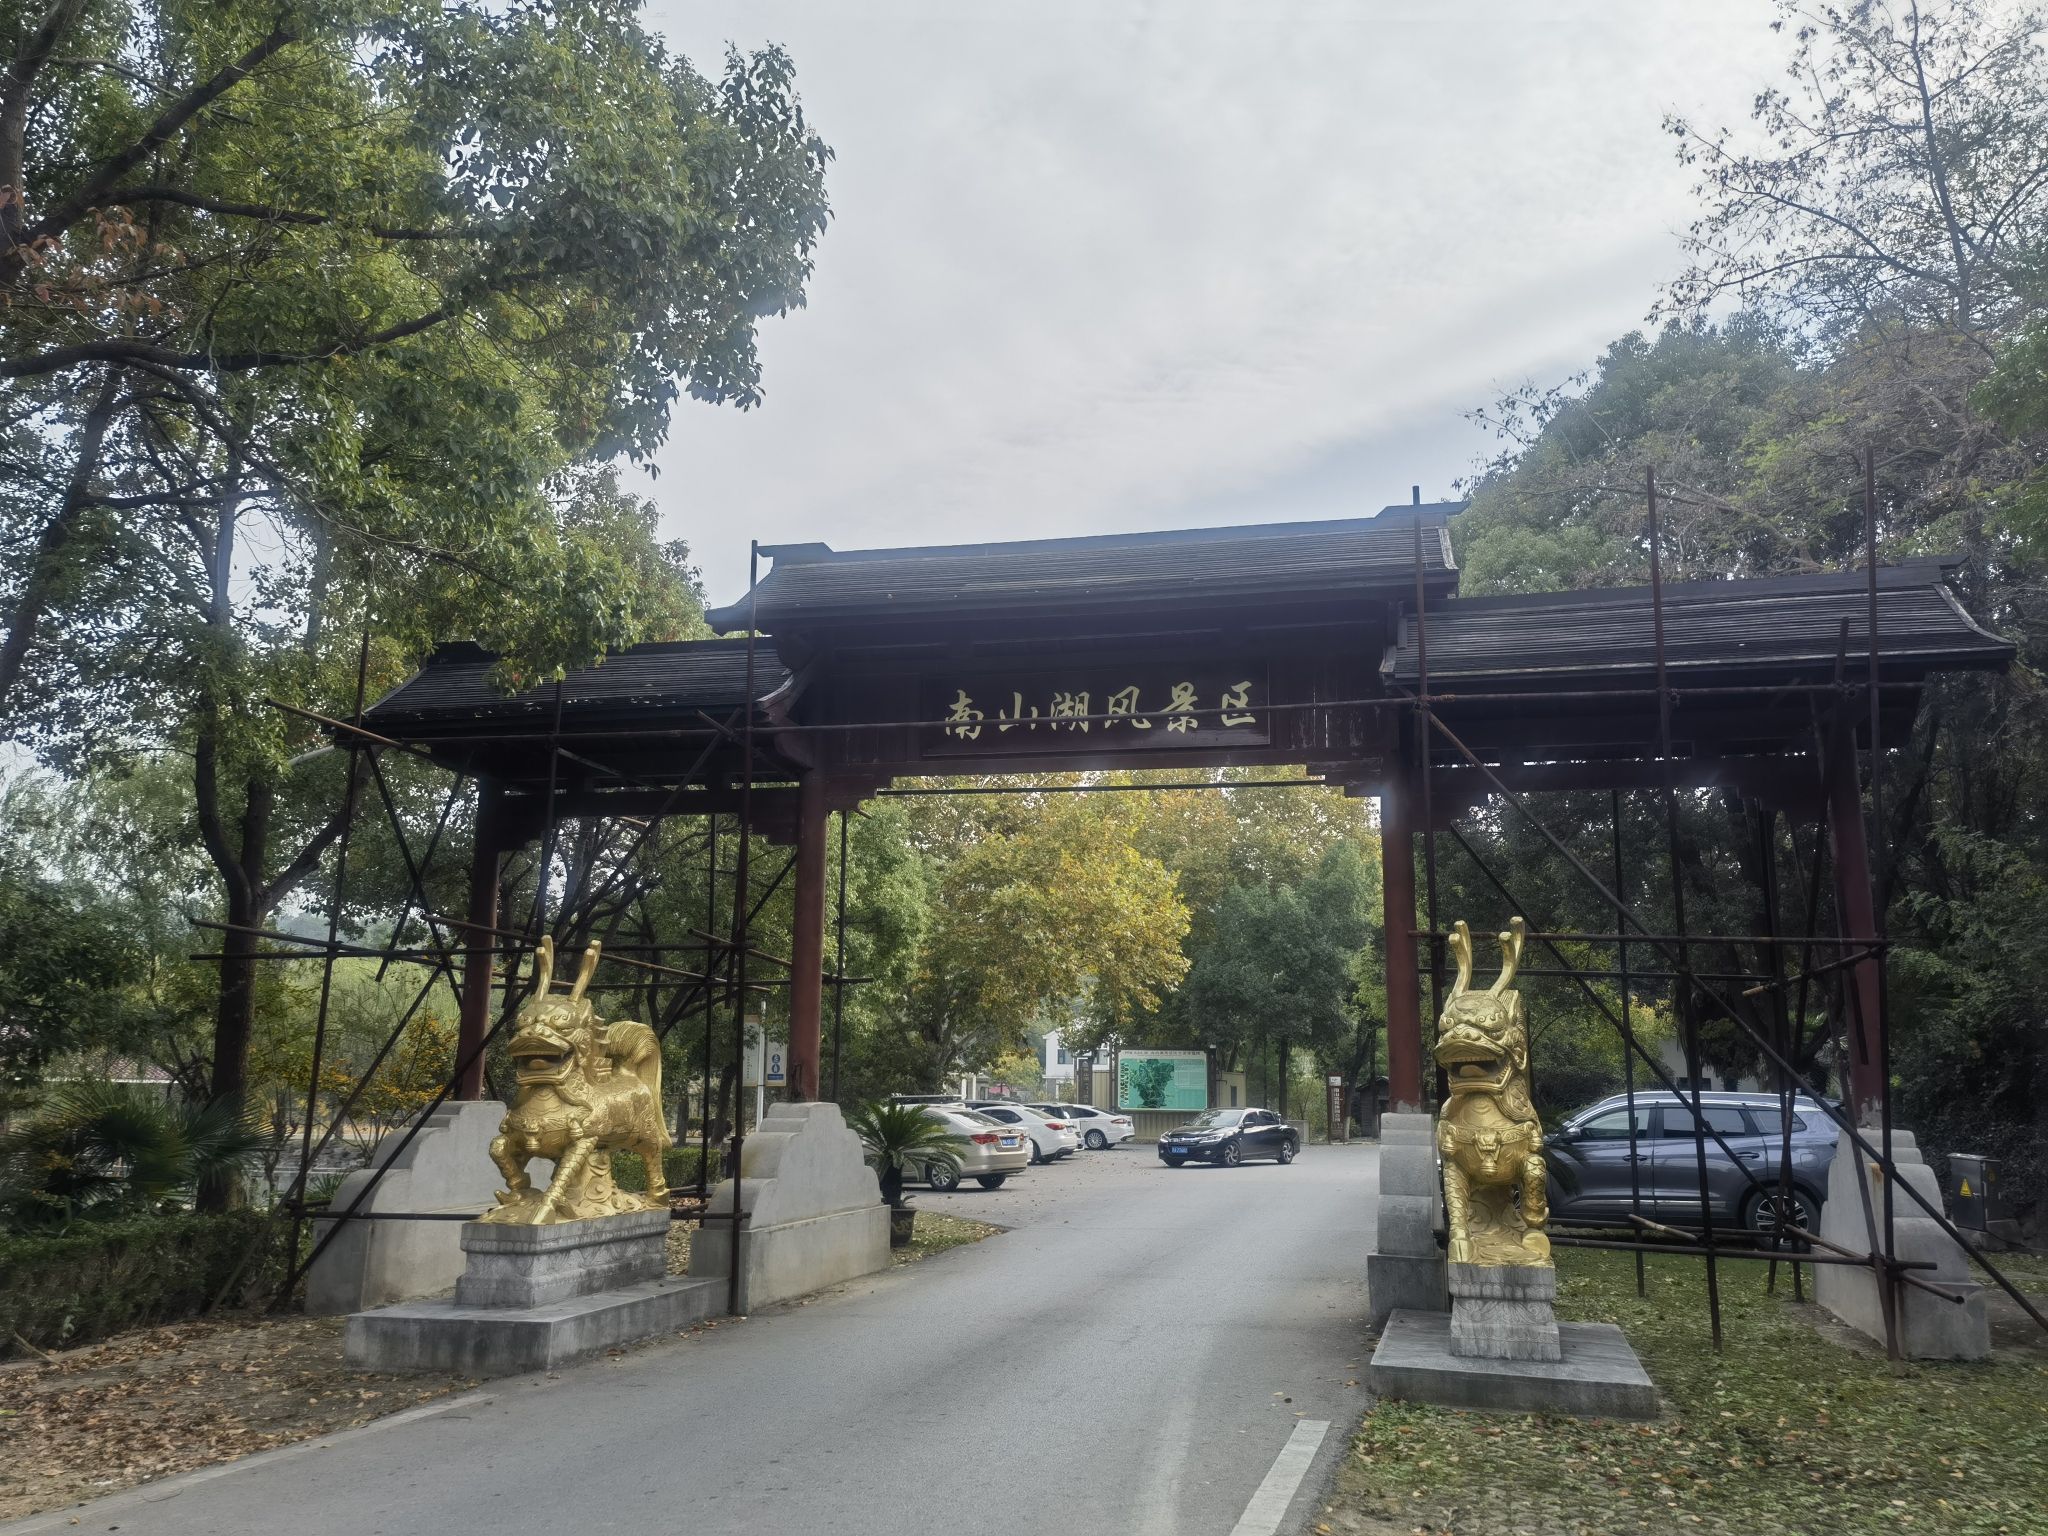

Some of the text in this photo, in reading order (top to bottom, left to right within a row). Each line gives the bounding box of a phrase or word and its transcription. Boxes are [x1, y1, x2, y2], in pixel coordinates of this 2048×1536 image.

[945, 681, 1256, 740] 南山湖风景区
